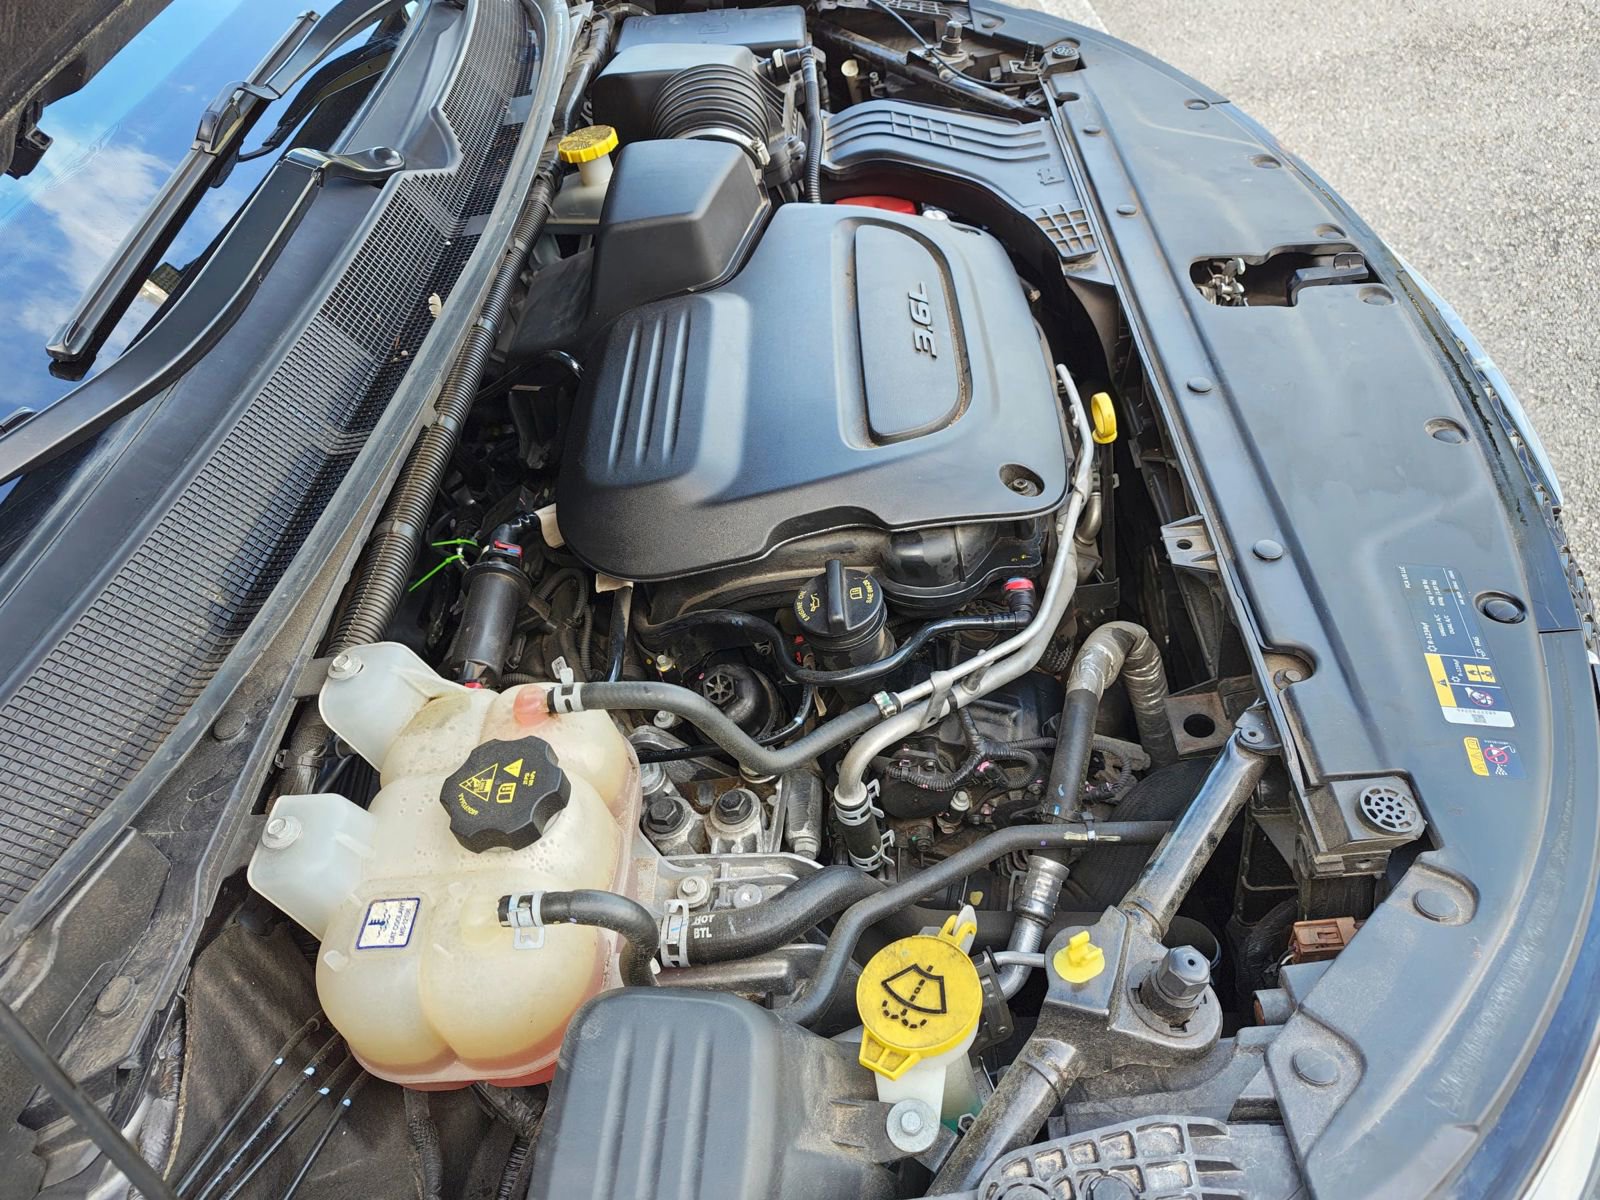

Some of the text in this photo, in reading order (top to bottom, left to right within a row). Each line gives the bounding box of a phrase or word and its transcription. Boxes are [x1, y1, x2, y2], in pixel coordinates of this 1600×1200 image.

[907, 281, 938, 359] 3.6L
[797, 590, 811, 621] ENGINE OIL
[865, 593, 874, 604] SAE
[1447, 623, 1456, 635] DUAL
[392, 901, 406, 931] COOLANT
[693, 926, 713, 940] BTL
